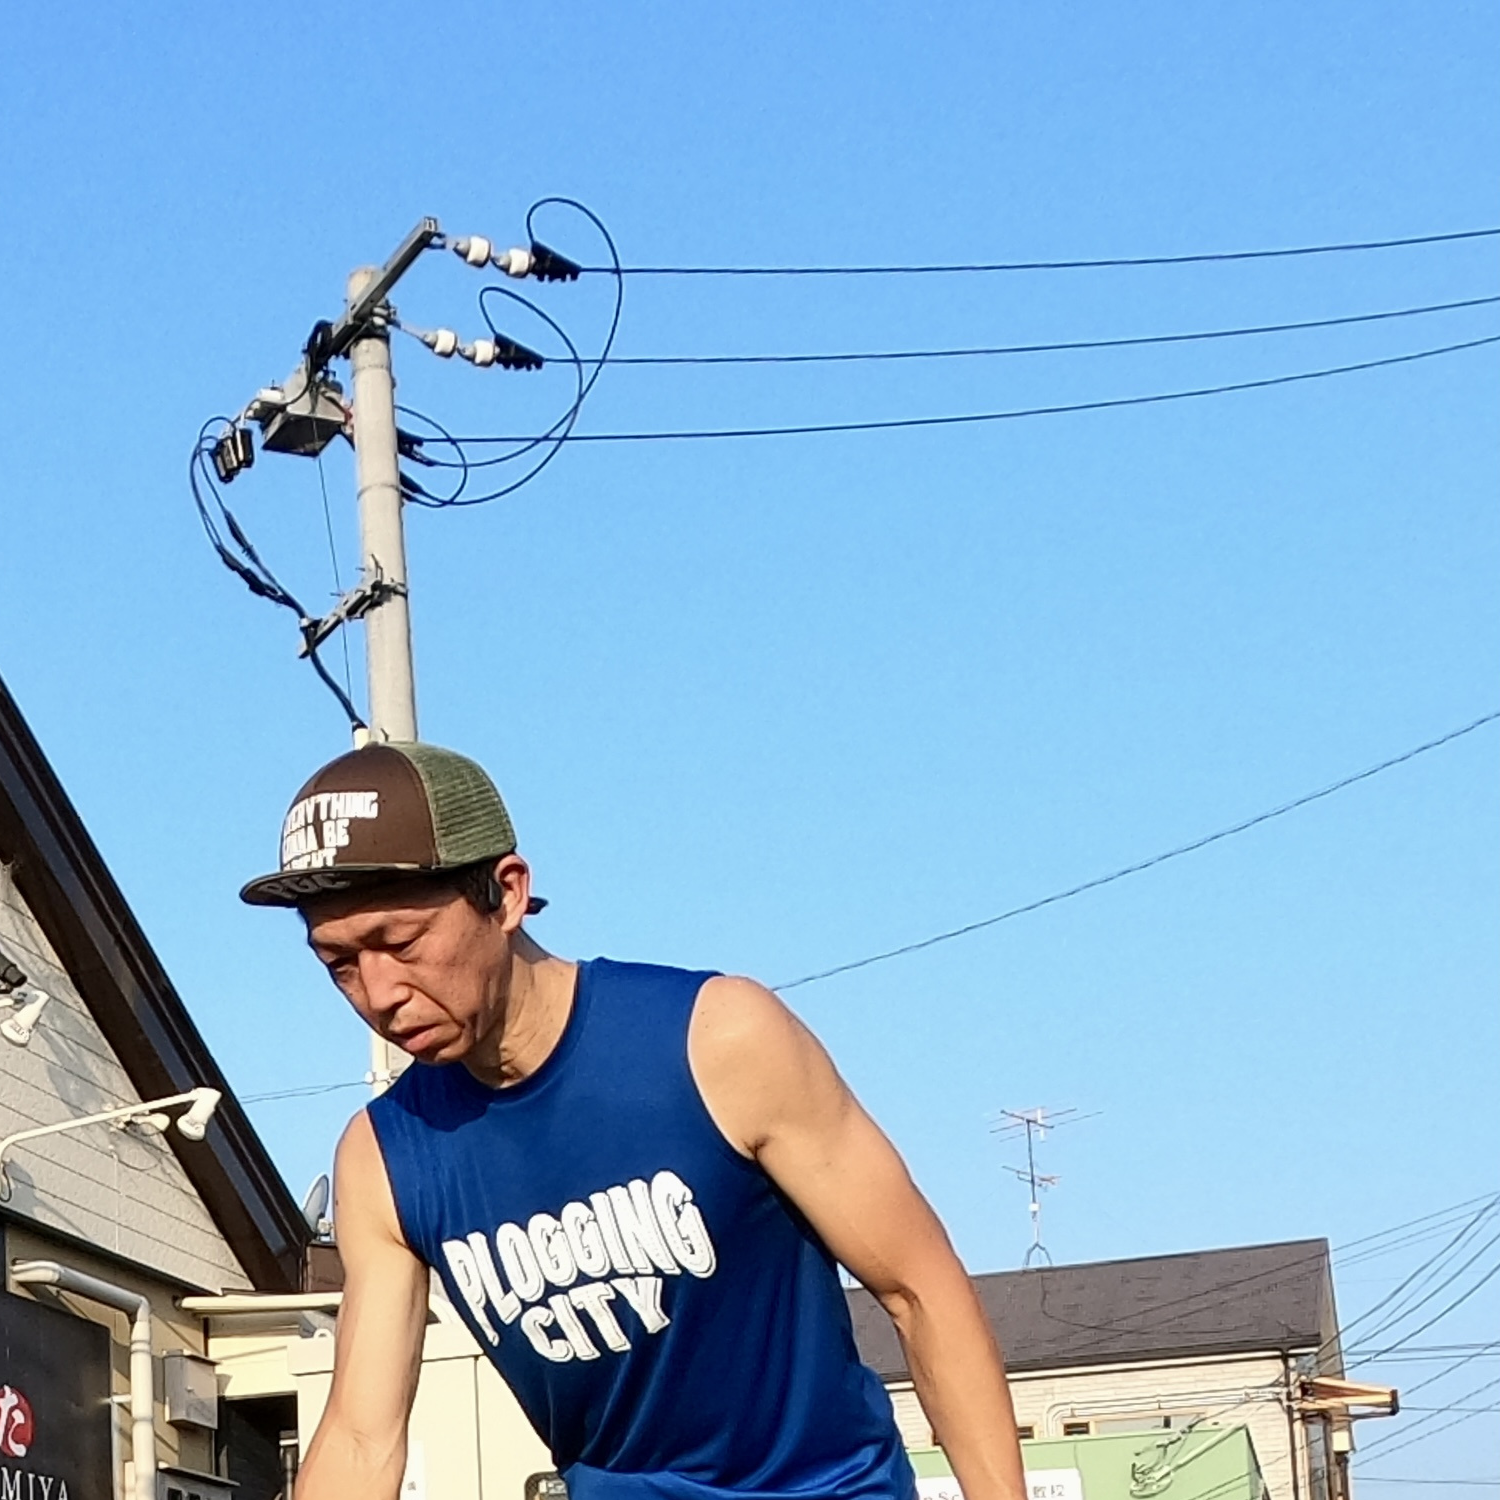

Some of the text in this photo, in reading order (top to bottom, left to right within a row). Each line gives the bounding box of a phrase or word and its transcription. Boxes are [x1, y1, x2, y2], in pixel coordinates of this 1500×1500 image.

[323, 818, 350, 848] BE
[441, 1169, 716, 1347] PLOGGING
[520, 1276, 671, 1362] CITY
